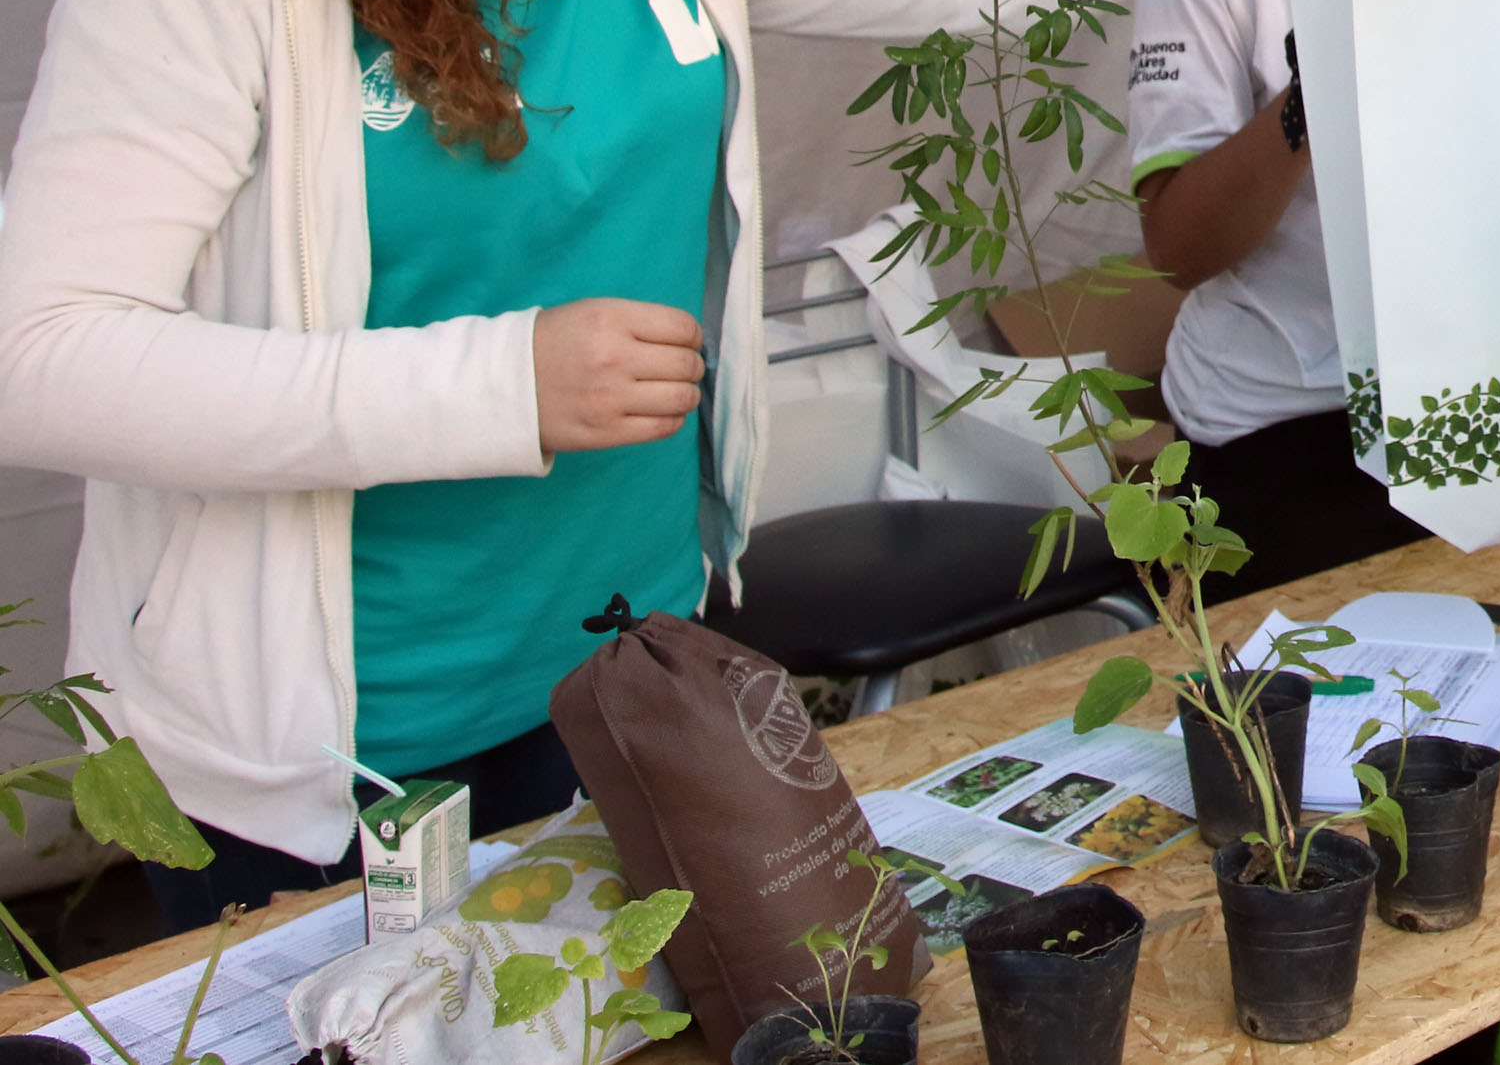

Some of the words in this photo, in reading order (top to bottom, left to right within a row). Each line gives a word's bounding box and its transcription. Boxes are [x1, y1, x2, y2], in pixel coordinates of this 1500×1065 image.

[758, 849, 831, 897] vegetales
[831, 837, 847, 855] de
[764, 824, 828, 869] Producto
[834, 862, 850, 879] de
